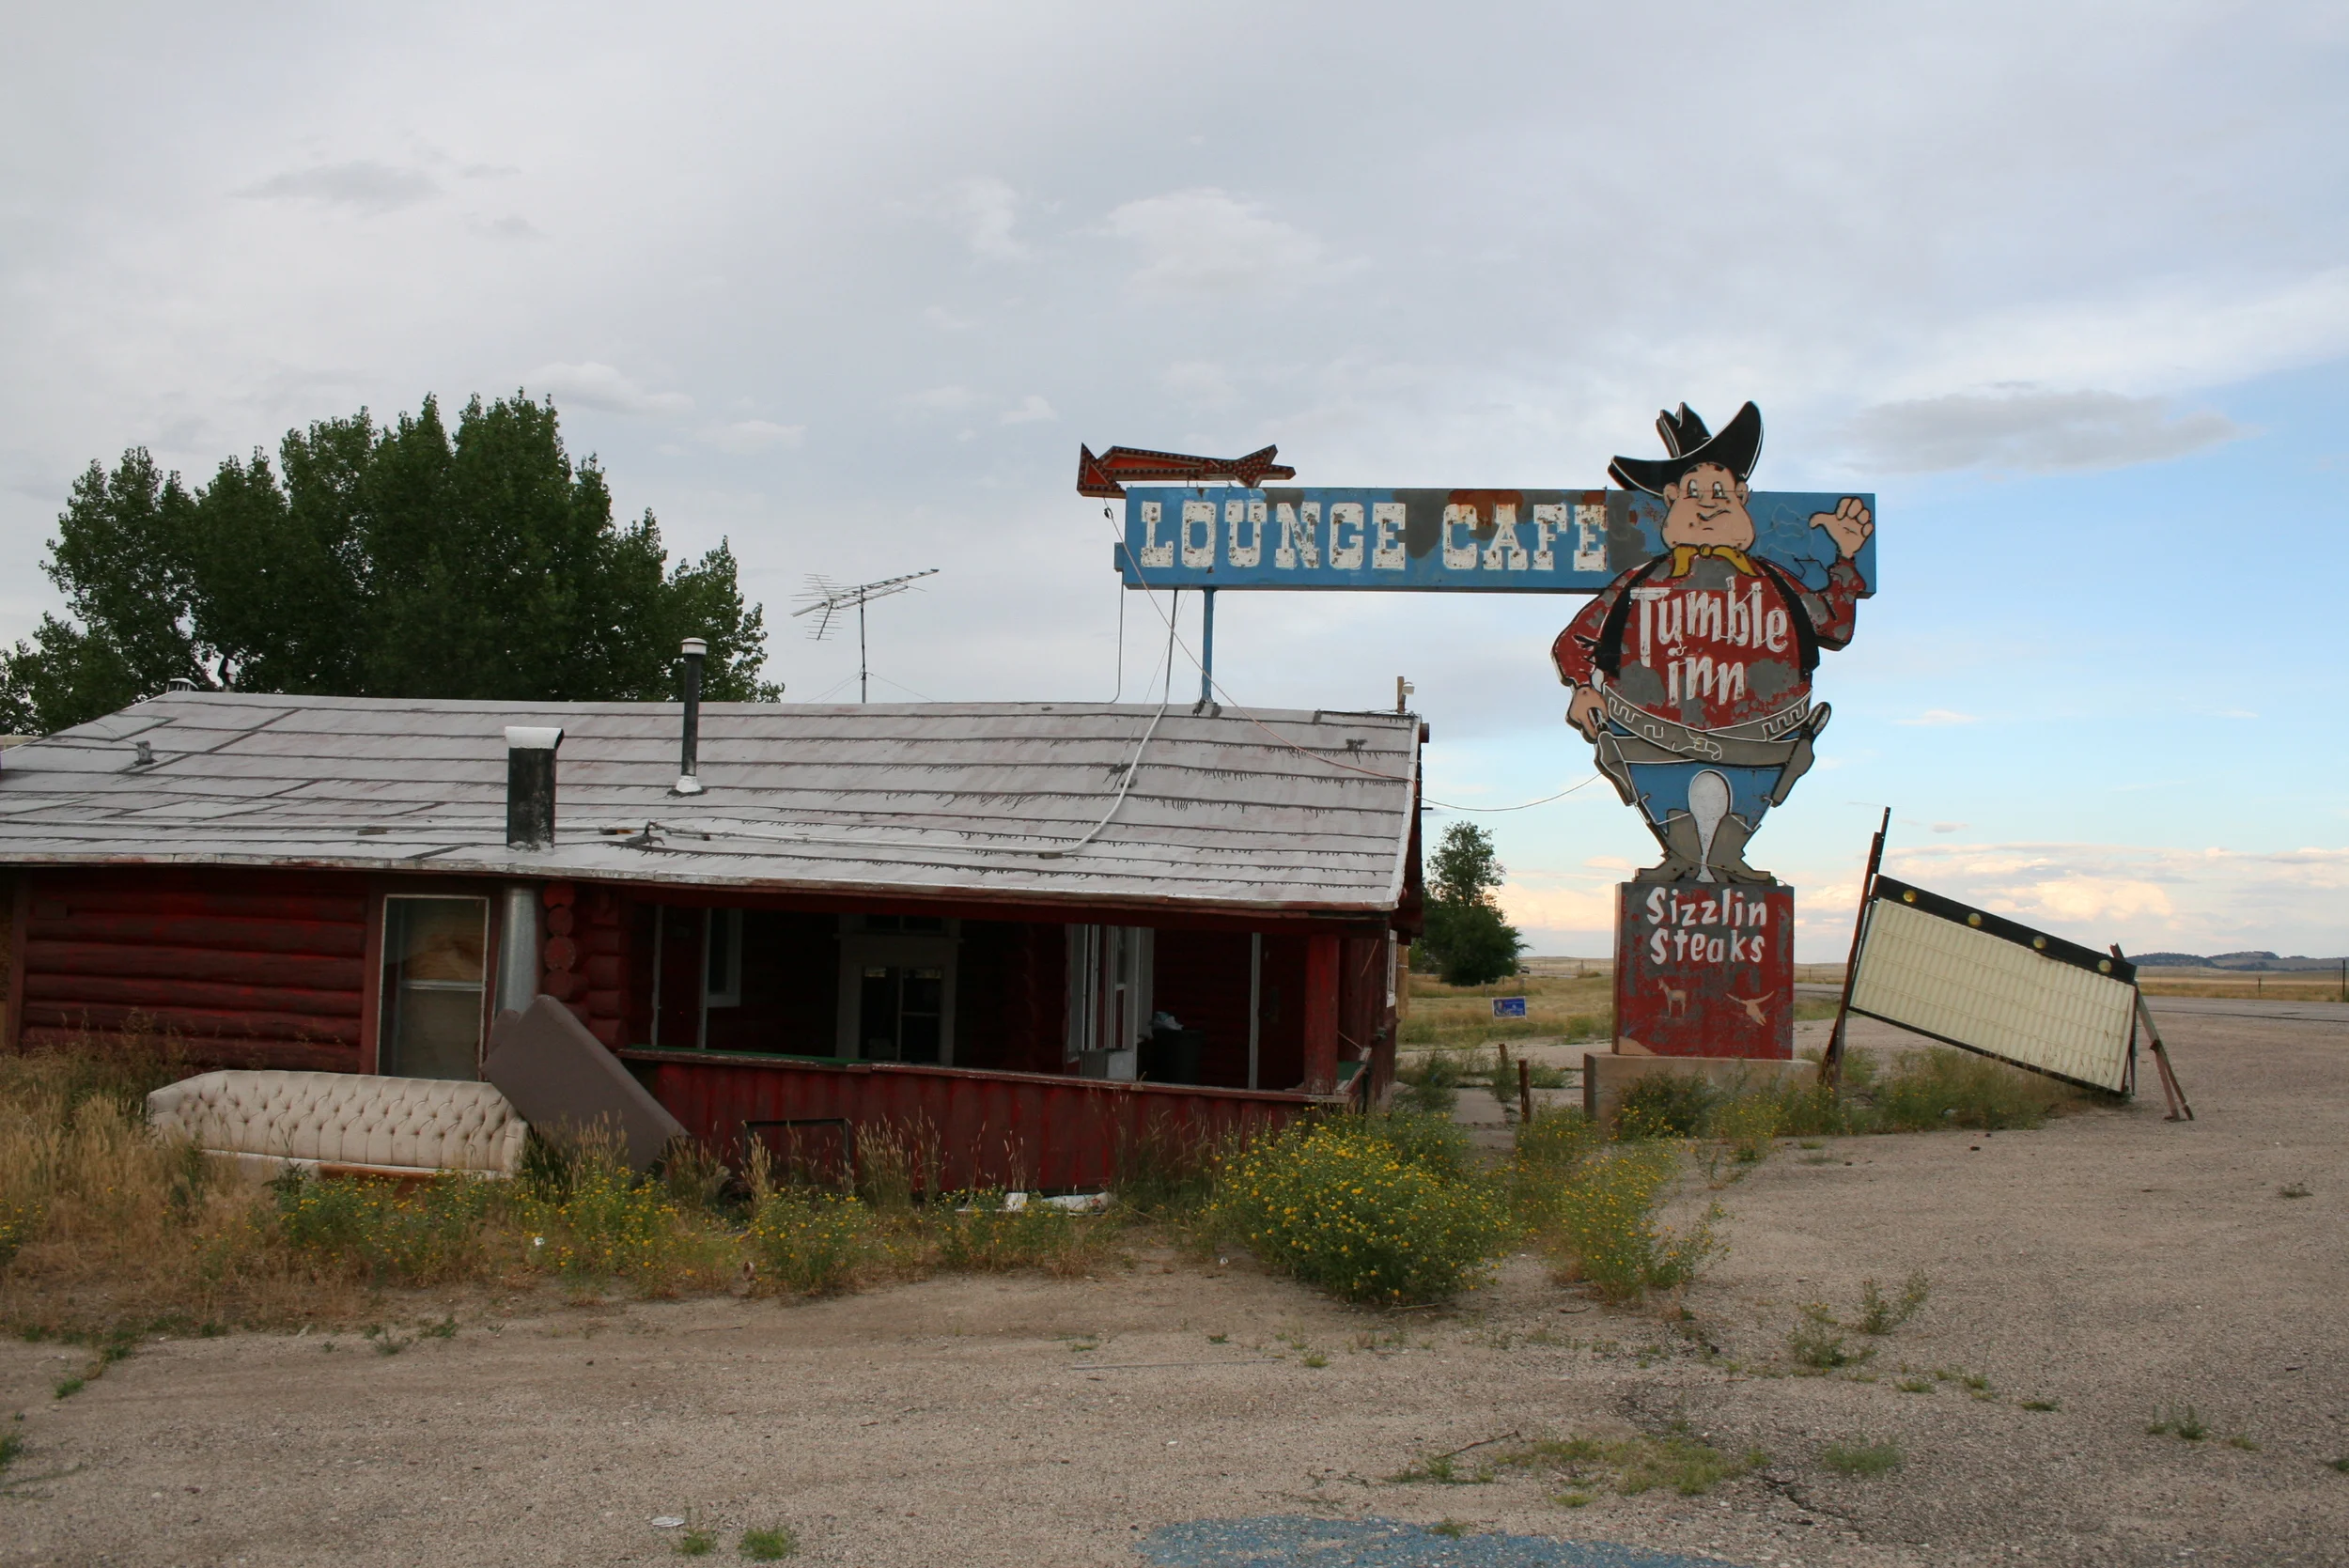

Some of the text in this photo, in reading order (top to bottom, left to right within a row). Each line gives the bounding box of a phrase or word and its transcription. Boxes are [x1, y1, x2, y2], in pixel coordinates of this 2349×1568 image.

[1140, 500, 1608, 573] LOUNGE CAFE
[1629, 575, 1788, 668] Tumble
[1667, 646, 1747, 706] inn
[1646, 886, 1767, 927] Sizzlin
[1650, 927, 1766, 965] Steaks
